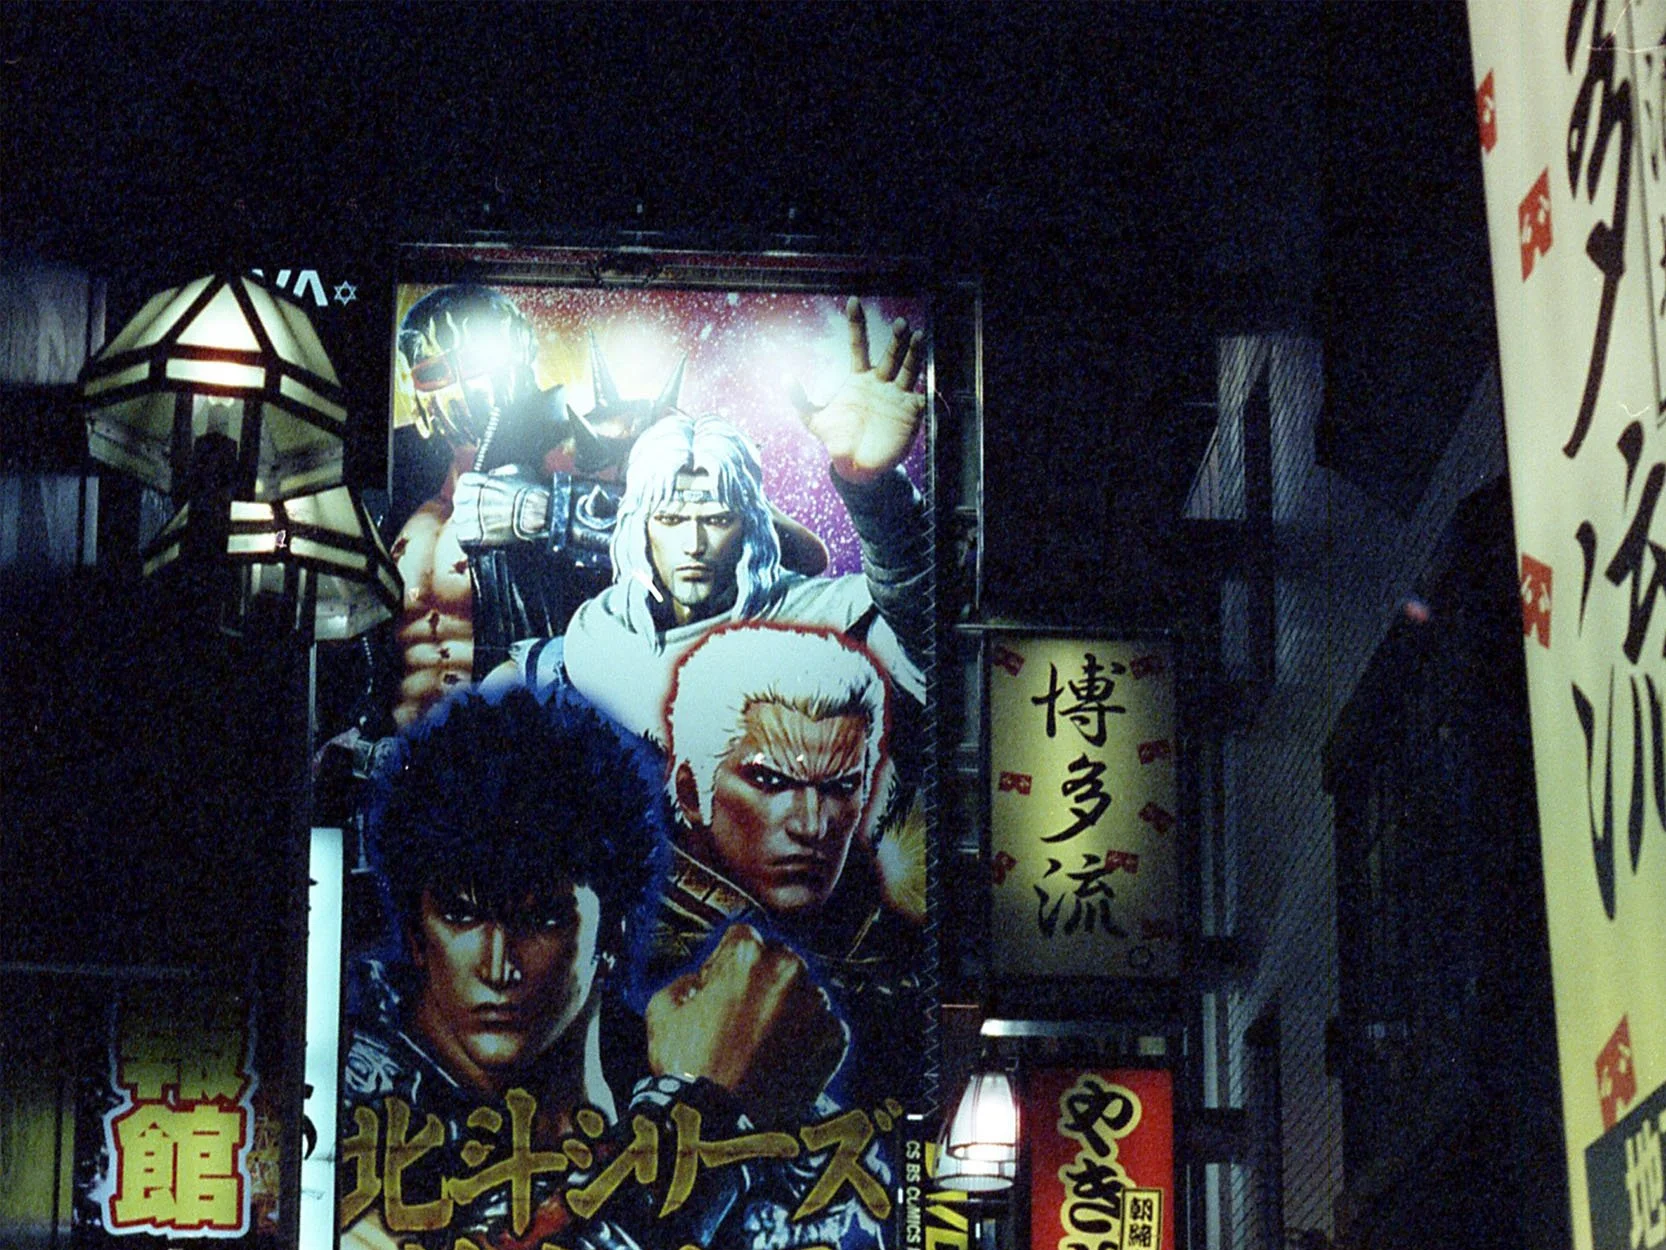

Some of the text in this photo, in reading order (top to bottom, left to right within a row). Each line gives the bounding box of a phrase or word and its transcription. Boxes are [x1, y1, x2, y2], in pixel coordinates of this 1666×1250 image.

[1031, 652, 1130, 940] 博多流
[339, 1088, 903, 1236] 北斗シリーズ
[906, 1140, 921, 1160] CS
[906, 1163, 921, 1184] BS
